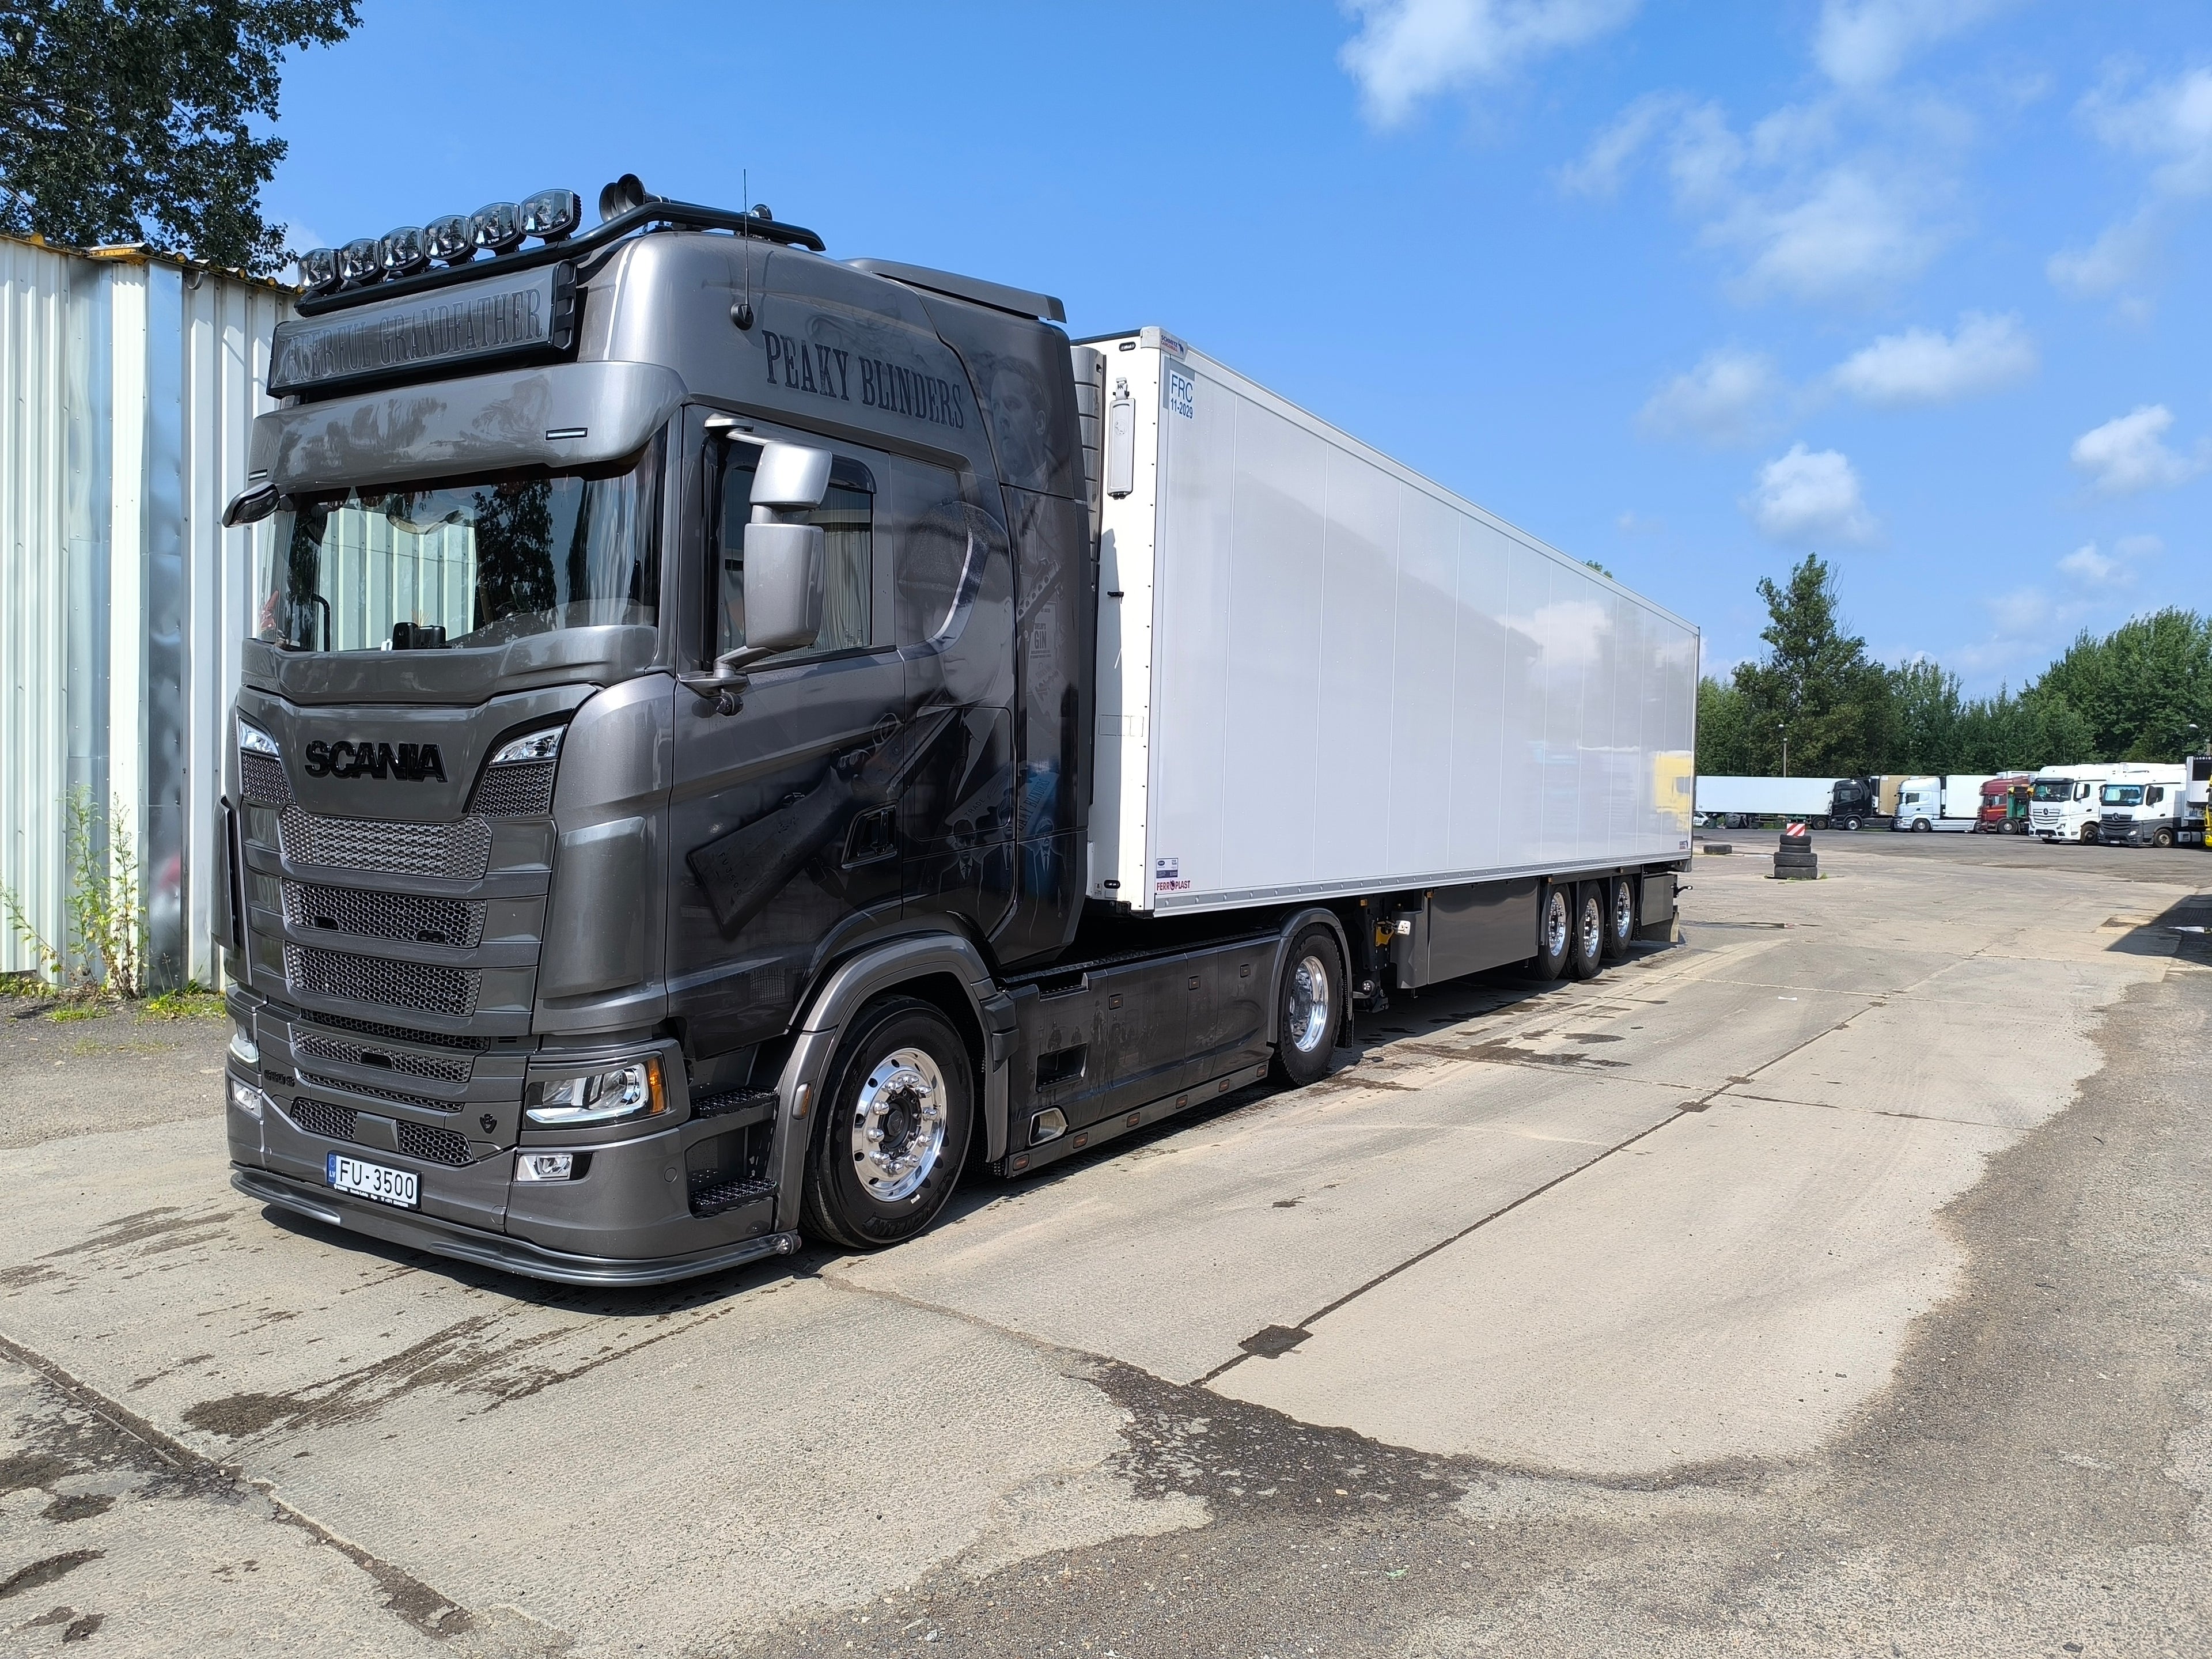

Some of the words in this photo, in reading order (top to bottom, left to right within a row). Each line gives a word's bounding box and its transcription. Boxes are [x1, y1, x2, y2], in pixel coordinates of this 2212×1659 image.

[378, 288, 543, 365] GRANDFATHER
[762, 329, 850, 402] PEAKY
[858, 355, 964, 429] BLINDERS
[1171, 374, 1193, 403] FRC
[1171, 397, 1193, 419] 11-2029
[1035, 630, 1047, 649] GIN
[304, 740, 448, 783] SCANIA
[1023, 778, 1050, 808] BLINDERS
[964, 798, 986, 817] TRADE
[726, 867, 742, 895] 3500
[1157, 880, 1191, 891] FERROPLAST
[329, 1170, 336, 1178] LV
[340, 1160, 414, 1199] FU-3500
